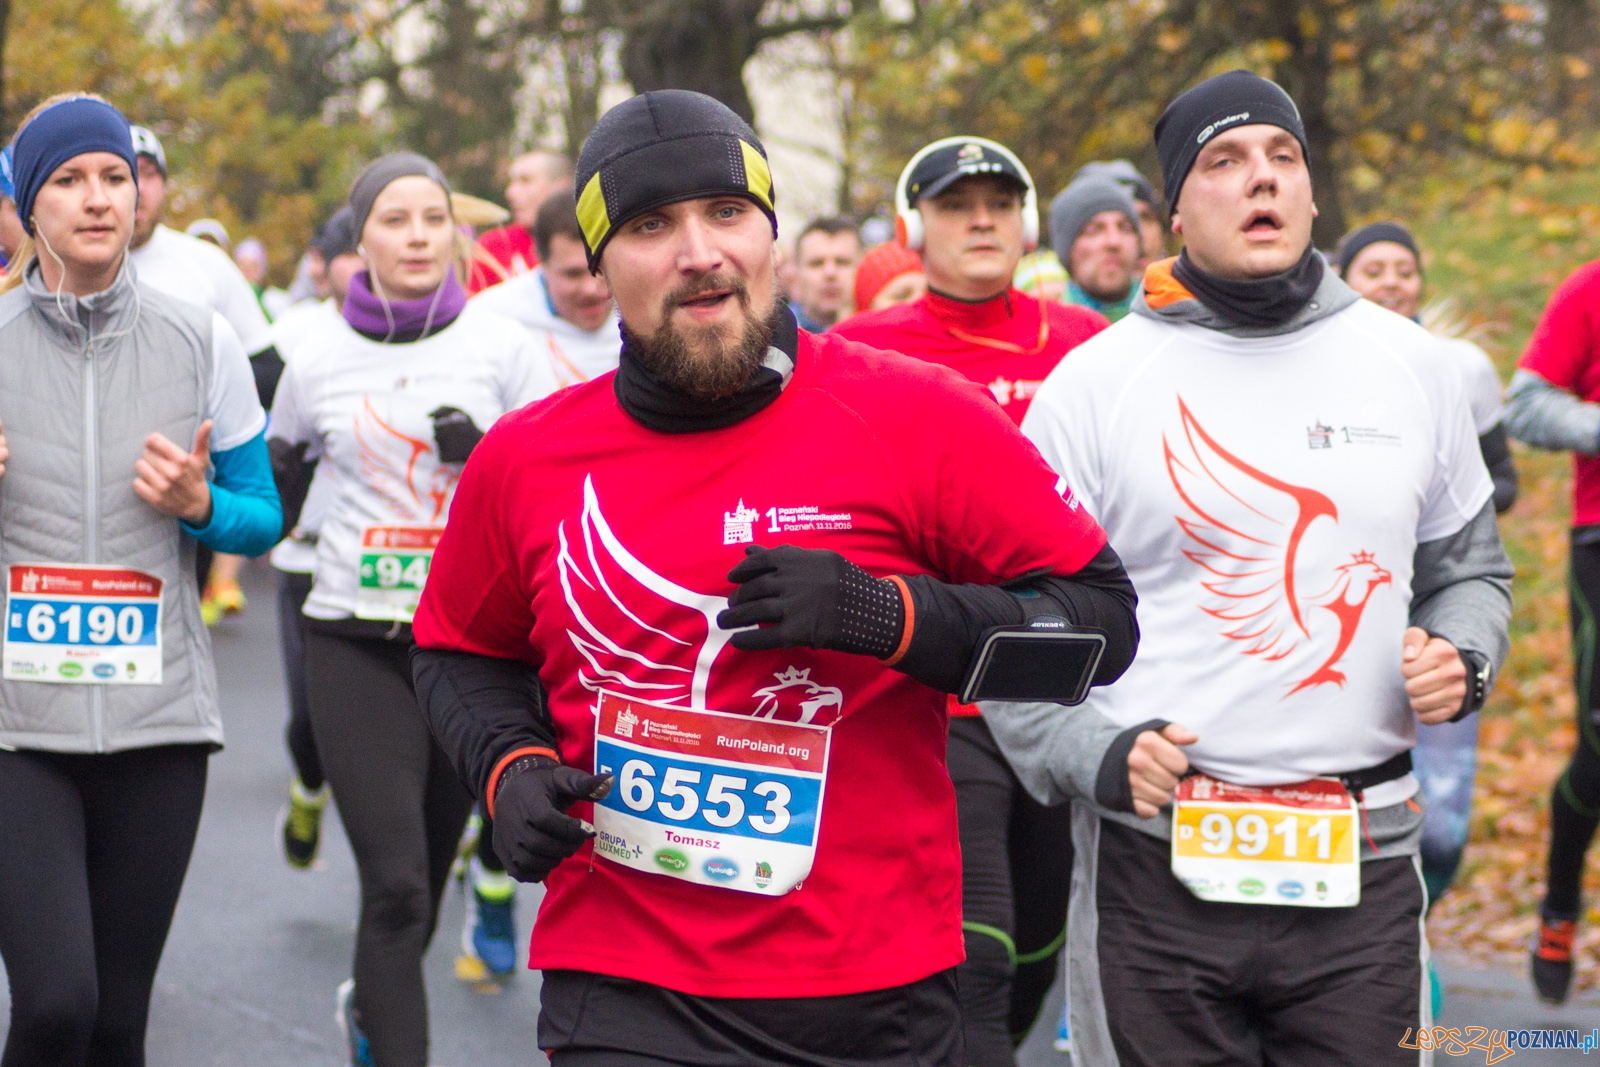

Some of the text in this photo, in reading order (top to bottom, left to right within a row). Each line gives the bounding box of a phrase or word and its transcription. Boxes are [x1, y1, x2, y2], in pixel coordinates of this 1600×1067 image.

[27, 603, 144, 644] 6190
[716, 735, 810, 761] RunPoland.org
[620, 759, 792, 834] 6553
[599, 831, 627, 849] GRUPA
[664, 830, 721, 850] Tomasz
[1179, 812, 1331, 859] D 9911
[599, 840, 632, 860] LUXMED
